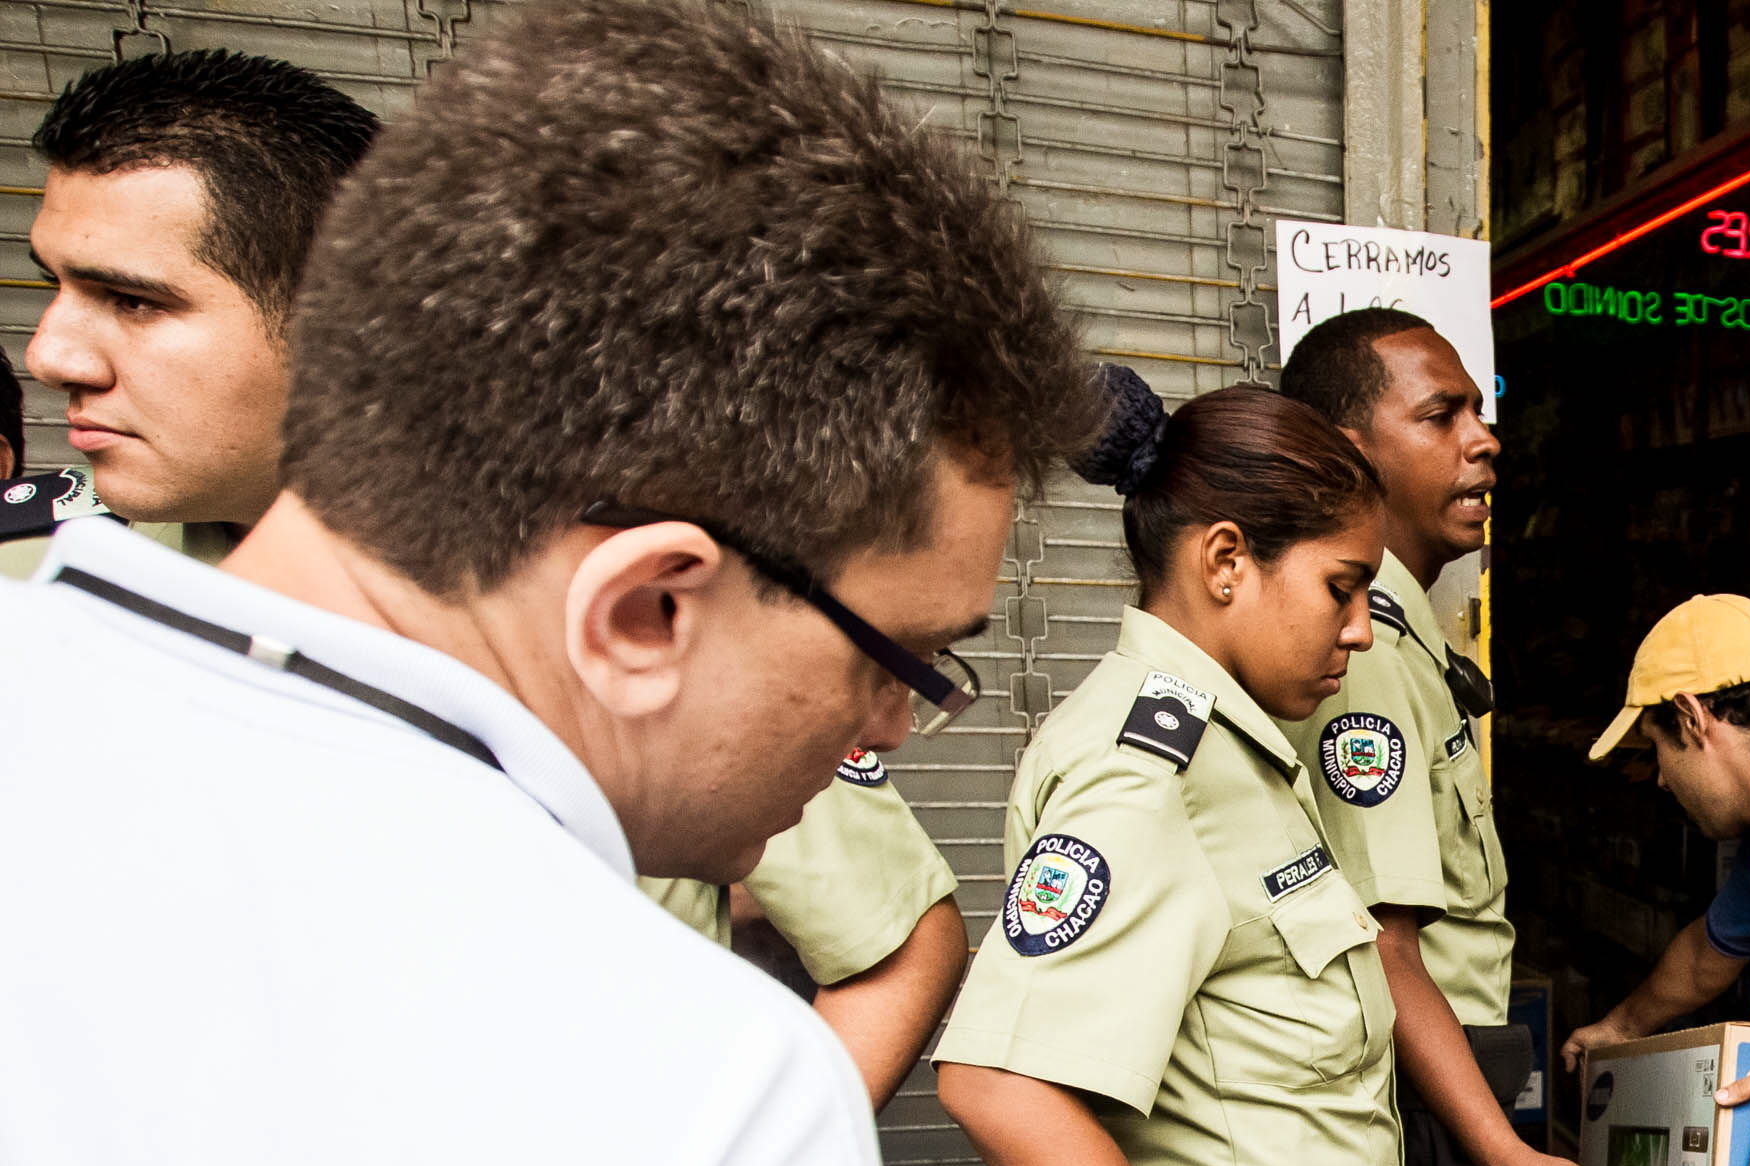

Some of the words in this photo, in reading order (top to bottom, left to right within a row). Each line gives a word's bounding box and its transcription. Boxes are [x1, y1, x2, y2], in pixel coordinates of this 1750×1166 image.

[1291, 229, 1451, 277] CERRAMOS
[1291, 292, 1312, 324] A
[1153, 673, 1208, 700] POLICIA
[1331, 716, 1391, 735] POLICIA
[1322, 739, 1356, 799] MUNICIPIO
[1376, 738, 1402, 796] CHACAO
[1036, 837, 1100, 874] POLICIA
[1276, 856, 1318, 890] PERALES
[1006, 858, 1032, 938] MUNICIPIO
[1044, 878, 1104, 948] CHACAO
